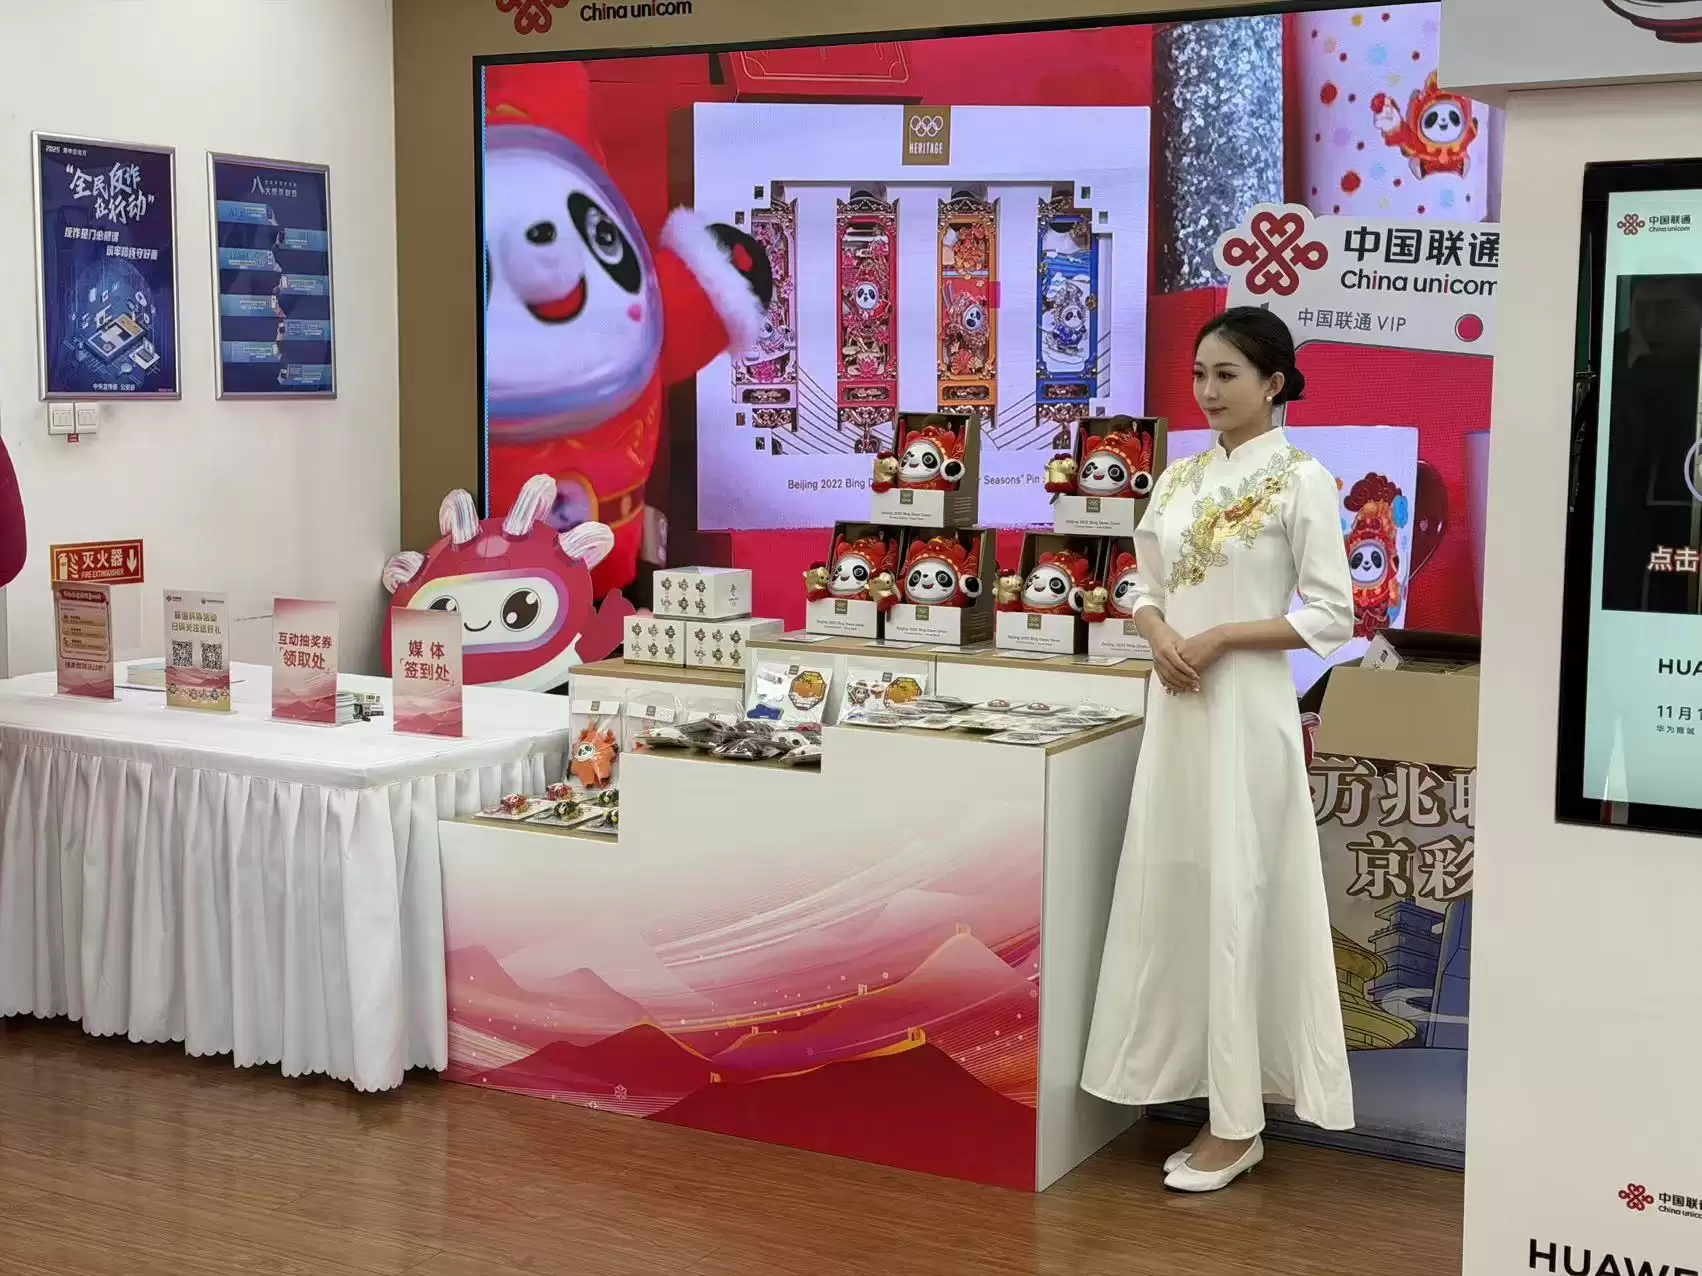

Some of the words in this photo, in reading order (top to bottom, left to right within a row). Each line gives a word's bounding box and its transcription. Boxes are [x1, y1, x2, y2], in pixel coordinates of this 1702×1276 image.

[580, 2, 628, 21] China
[630, 0, 692, 18] unicom
[909, 142, 943, 154] HERITAGE
[1649, 214, 1691, 225] 中国联通
[1344, 226, 1500, 268] 中国联通
[1341, 268, 1408, 292] China
[1298, 308, 1372, 331] 中国联通
[1377, 315, 1407, 332] VIP
[787, 479, 819, 491] Beijing
[820, 478, 843, 489] 2022
[845, 478, 866, 490] Bing
[1026, 474, 1040, 484] Pin
[82, 548, 124, 570] 灭火器
[1648, 545, 1699, 572] 点击
[278, 632, 333, 649] 互动抽奖券
[408, 639, 446, 660] 媒体
[1656, 724, 1696, 736] 华为商城
[1346, 831, 1474, 900] 京彩
[1658, 1192, 1702, 1210] 中国联
[1658, 1205, 1681, 1215] China
